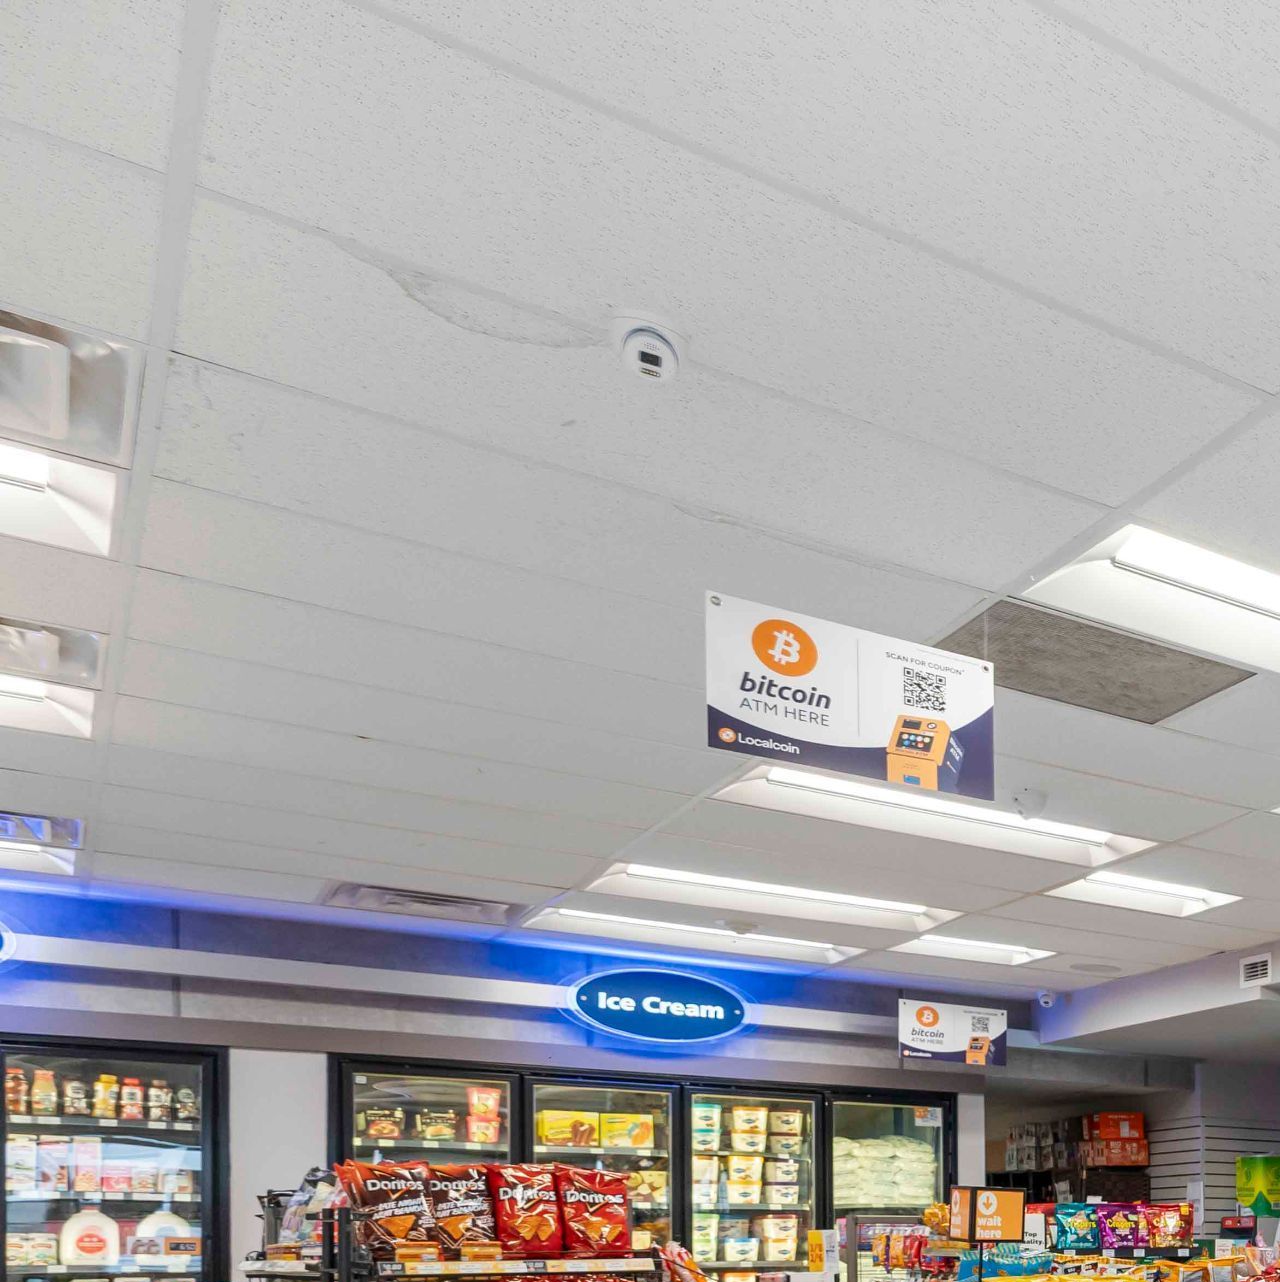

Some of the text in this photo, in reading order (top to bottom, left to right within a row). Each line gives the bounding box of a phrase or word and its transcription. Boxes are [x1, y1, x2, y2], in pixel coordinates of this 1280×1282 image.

[885, 651, 908, 663] SCAN
[910, 657, 926, 667] FOR
[740, 671, 831, 710] bitcoin
[740, 697, 830, 727] ATM HERE
[737, 732, 800, 755] Localcoin
[598, 991, 725, 1021] Ice Cream
[911, 1027, 945, 1039] bitcoin
[367, 1179, 424, 1191] Doritos
[430, 1179, 485, 1191] Doritos
[566, 1190, 624, 1205] Doritos
[977, 1217, 1002, 1227] wait
[977, 1228, 1002, 1239] here
